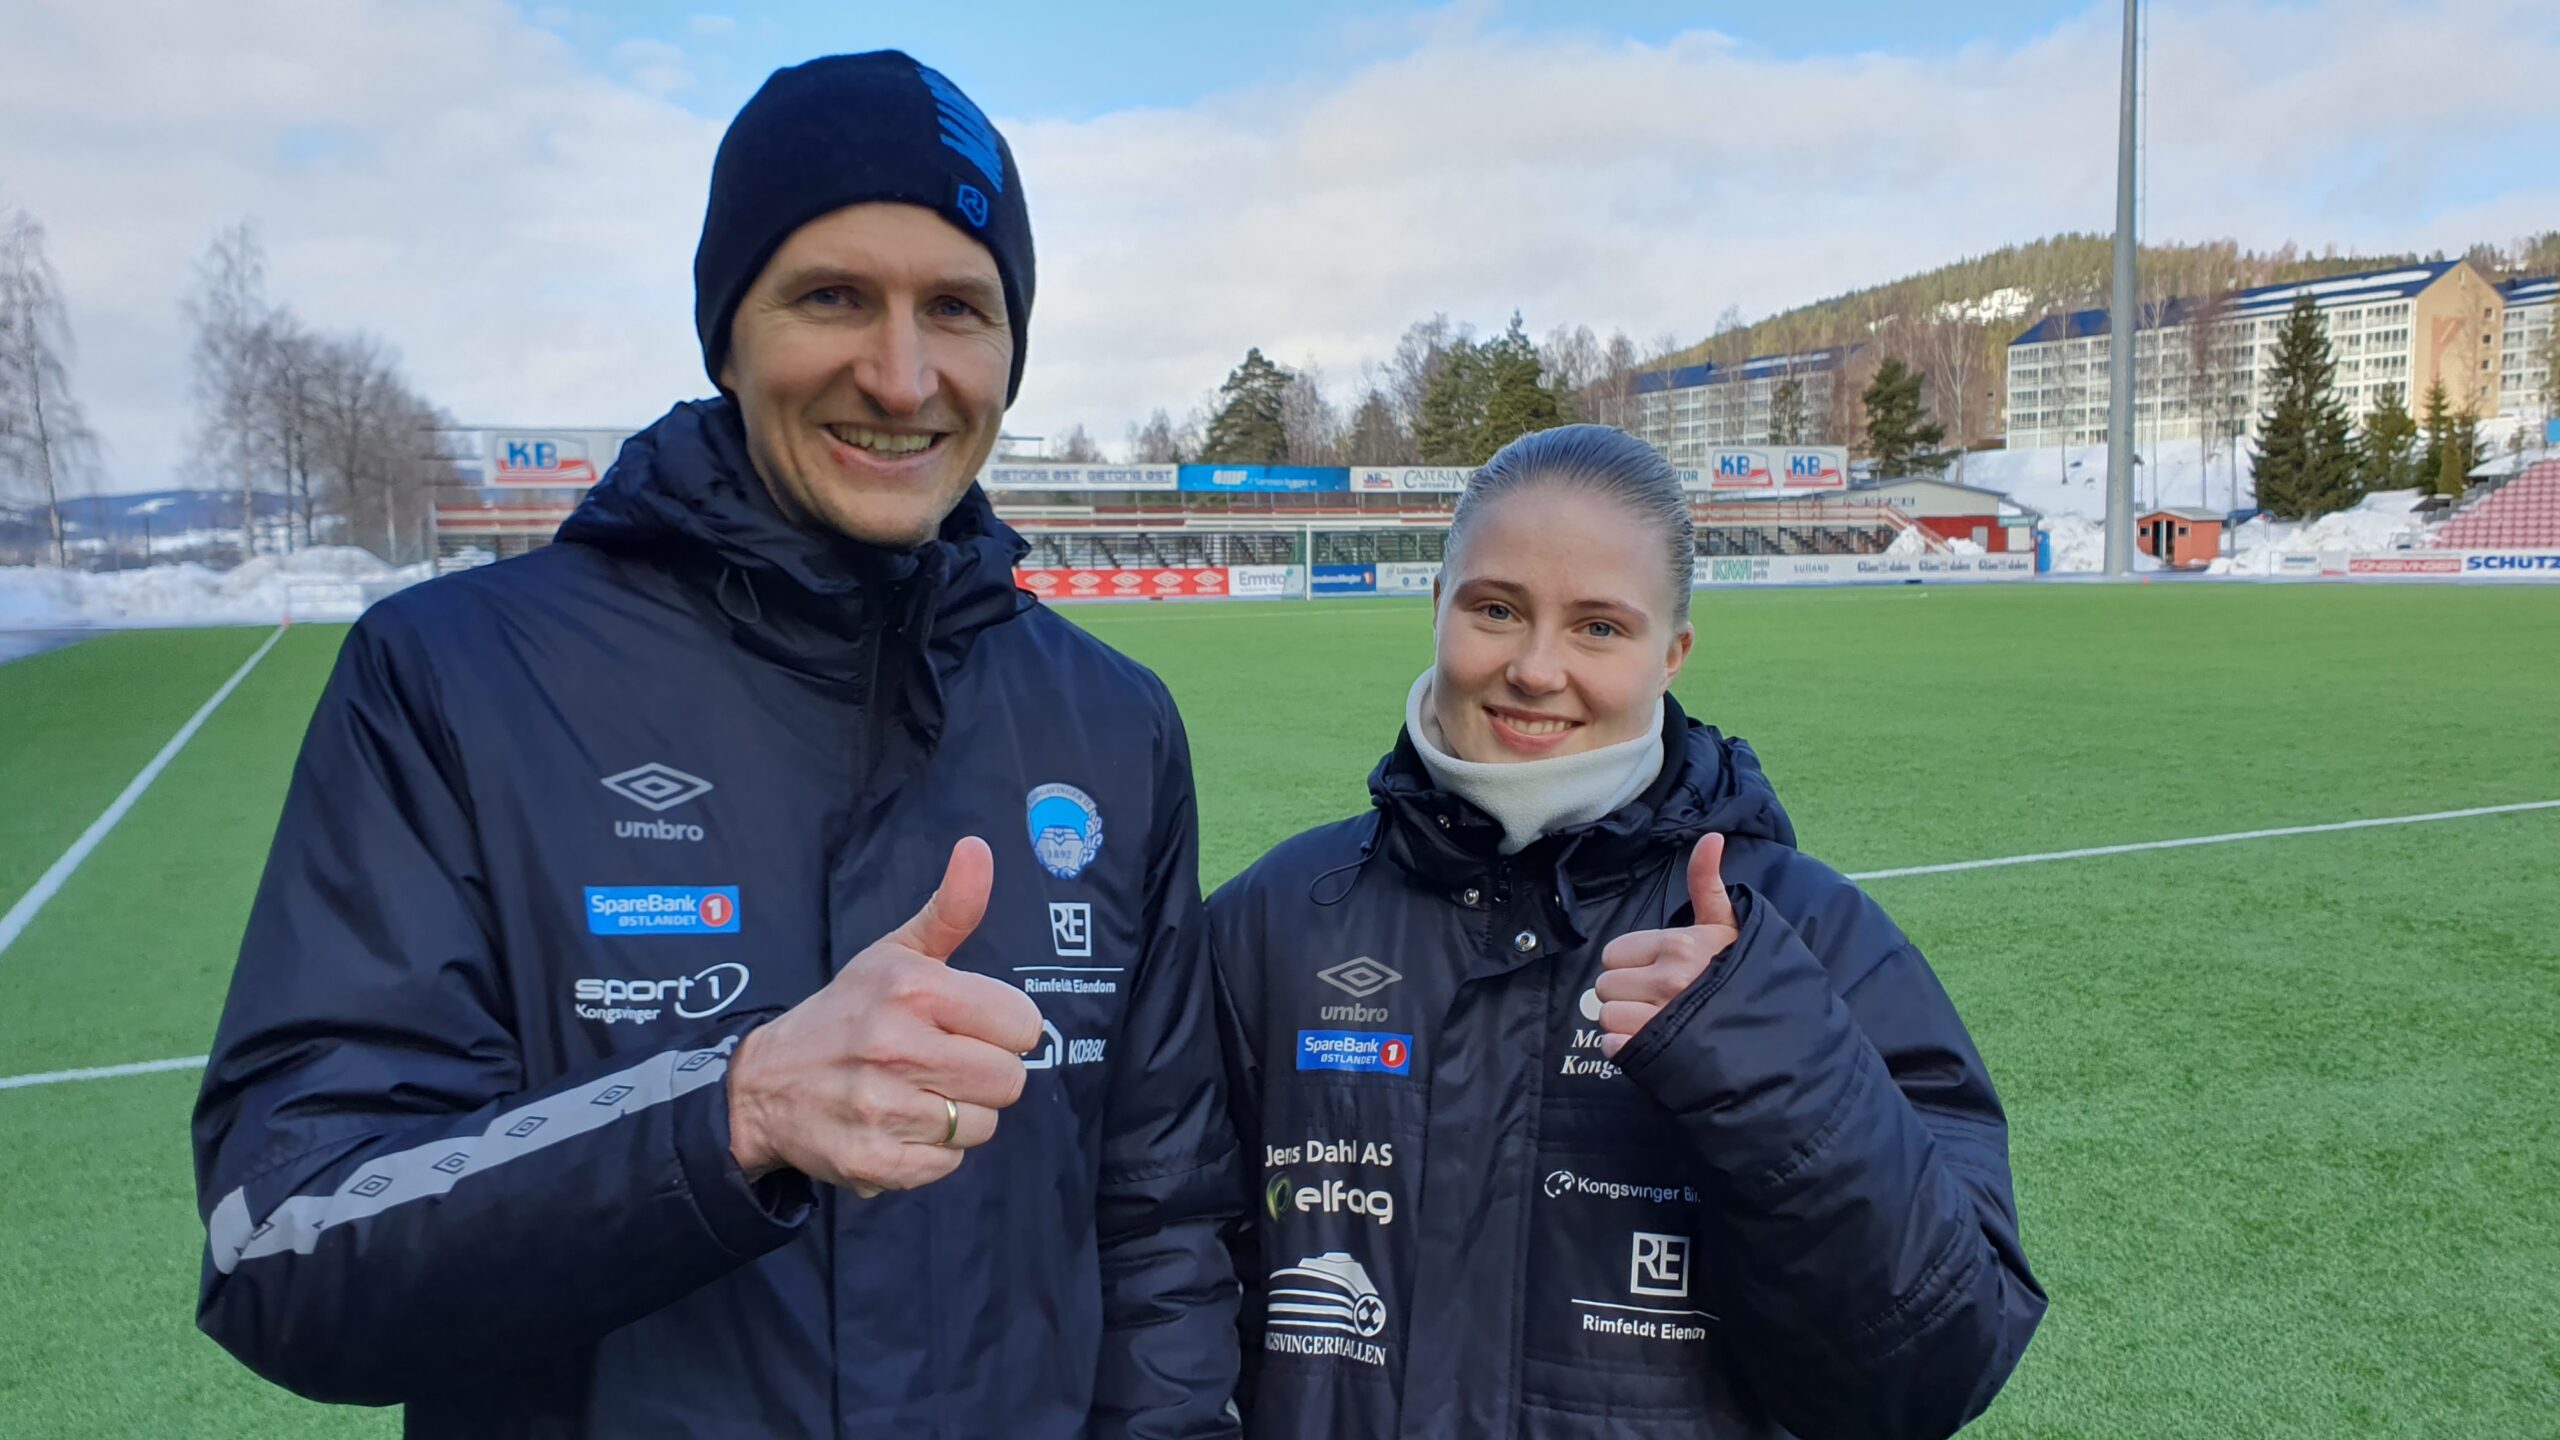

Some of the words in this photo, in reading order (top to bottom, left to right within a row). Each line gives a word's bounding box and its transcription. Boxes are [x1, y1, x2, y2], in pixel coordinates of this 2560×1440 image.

[507, 442, 558, 469] KB
[1721, 455, 1750, 476] KB
[1792, 455, 1820, 476] KB
[1712, 559, 1752, 581] KIWI
[614, 819, 704, 842] umbro
[591, 894, 697, 916] SpareBank
[618, 915, 698, 927] ØSTLANDET
[575, 976, 695, 1006] sport
[708, 976, 720, 999] 1
[1073, 979, 1116, 993] Eiendom
[575, 1004, 661, 1024] Kongsvinger
[1320, 1003, 1388, 1022] umbro
[1304, 1037, 1380, 1053] SpareBank
[1320, 1054, 1378, 1065] ØSTLANDET
[1306, 1139, 1357, 1163] Dahl
[1361, 1142, 1393, 1167] AS
[1578, 1177, 1680, 1203] Kongsvinger
[1295, 1180, 1394, 1225] elfag
[1582, 1314, 1656, 1338] Rimfeldt
